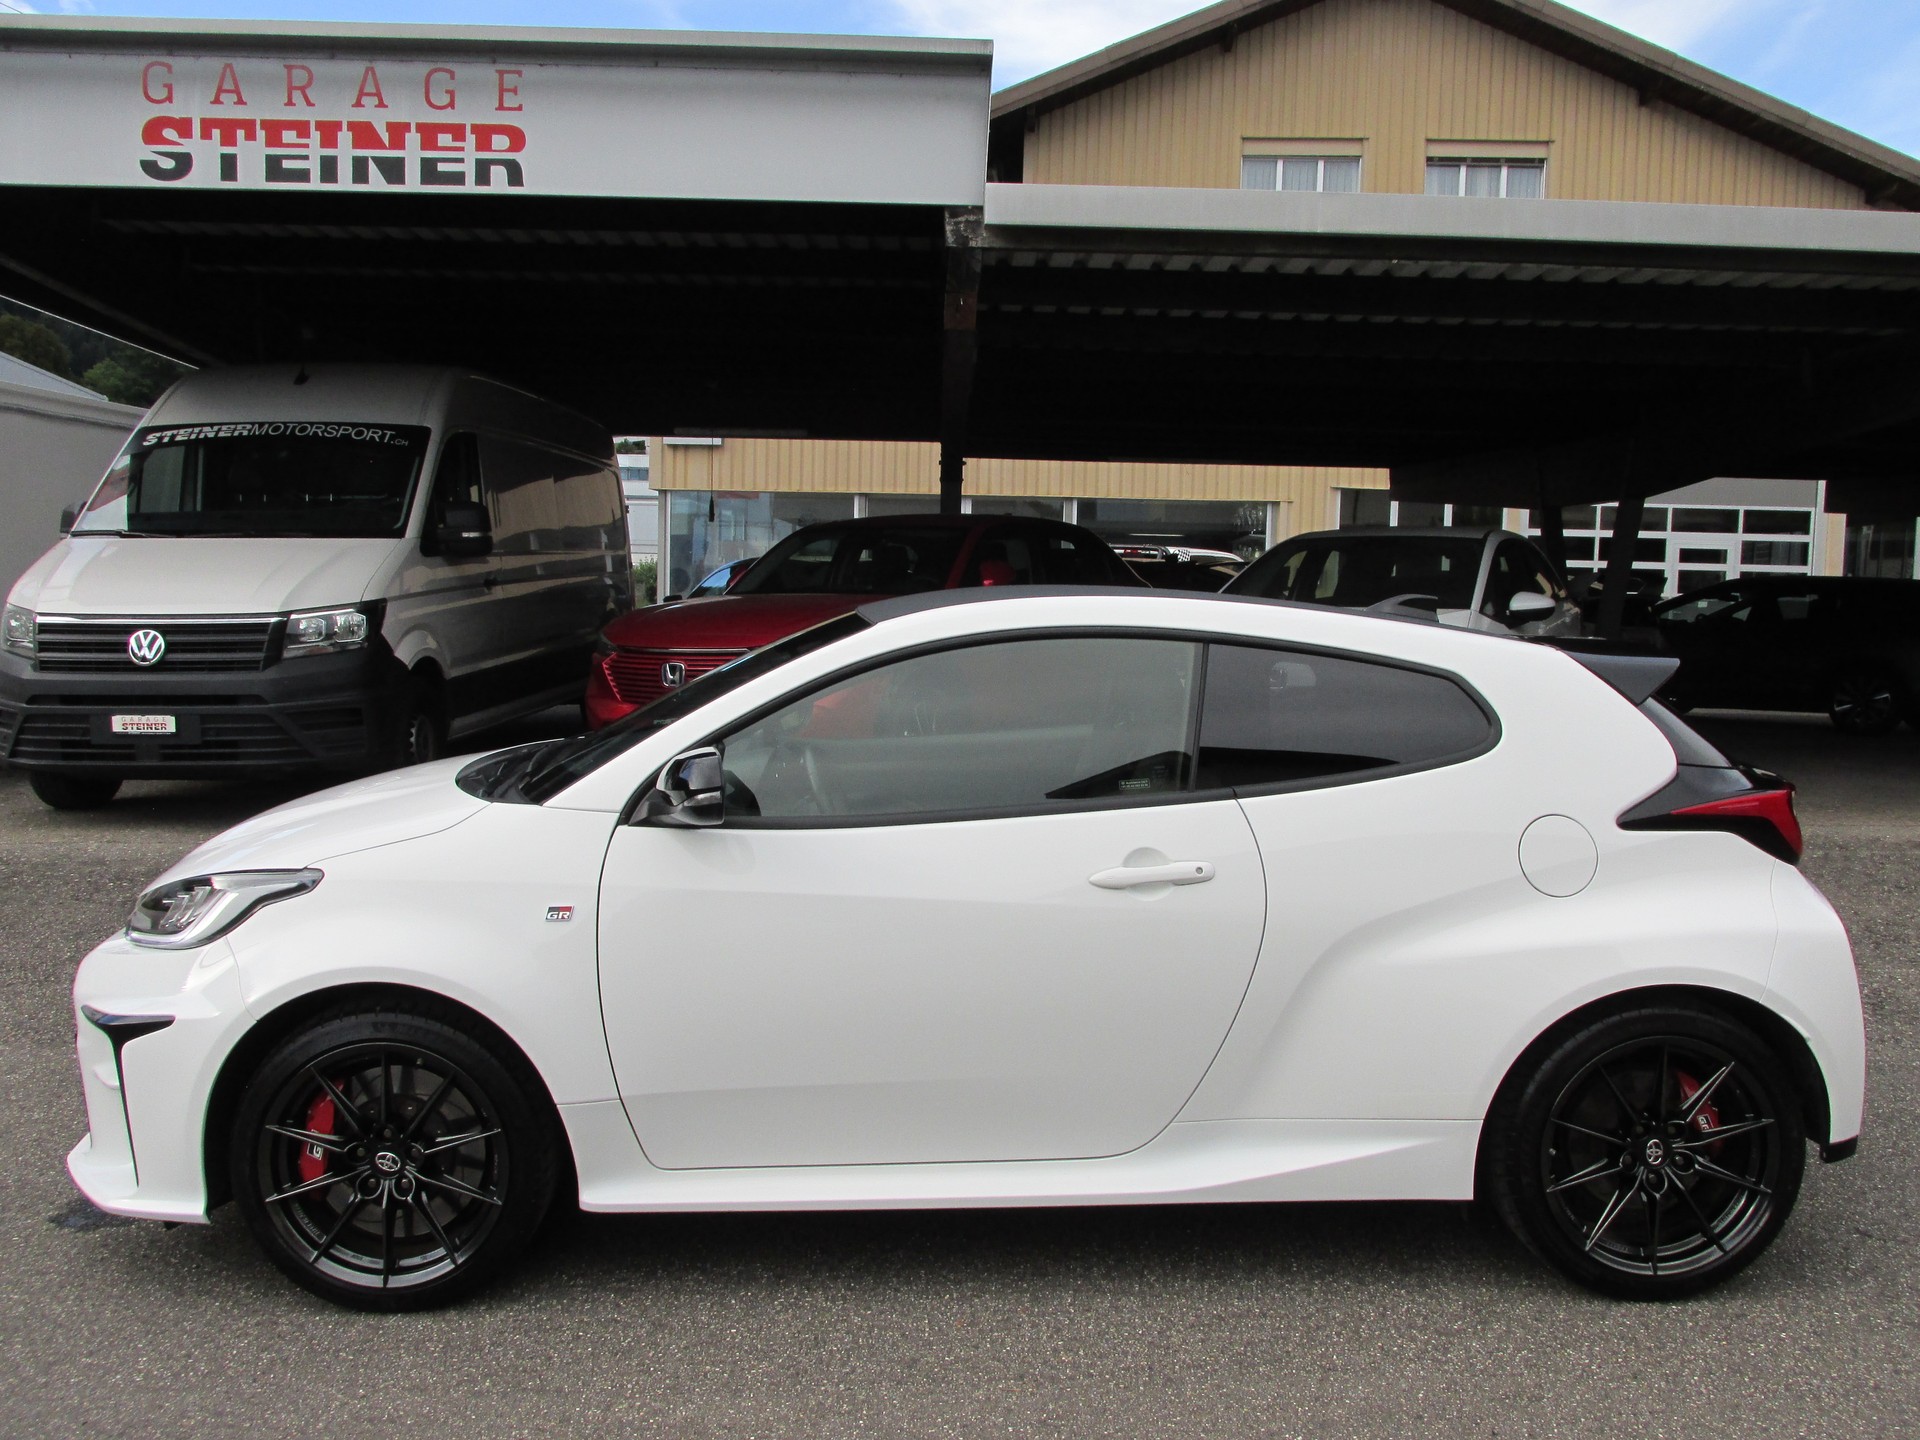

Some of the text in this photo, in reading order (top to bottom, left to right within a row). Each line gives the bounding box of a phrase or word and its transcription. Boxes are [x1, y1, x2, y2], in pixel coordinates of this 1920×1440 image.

[141, 61, 525, 112] GARAGE
[139, 115, 527, 188] STEINER
[121, 722, 167, 731] STEINER
[547, 911, 571, 920] GR
